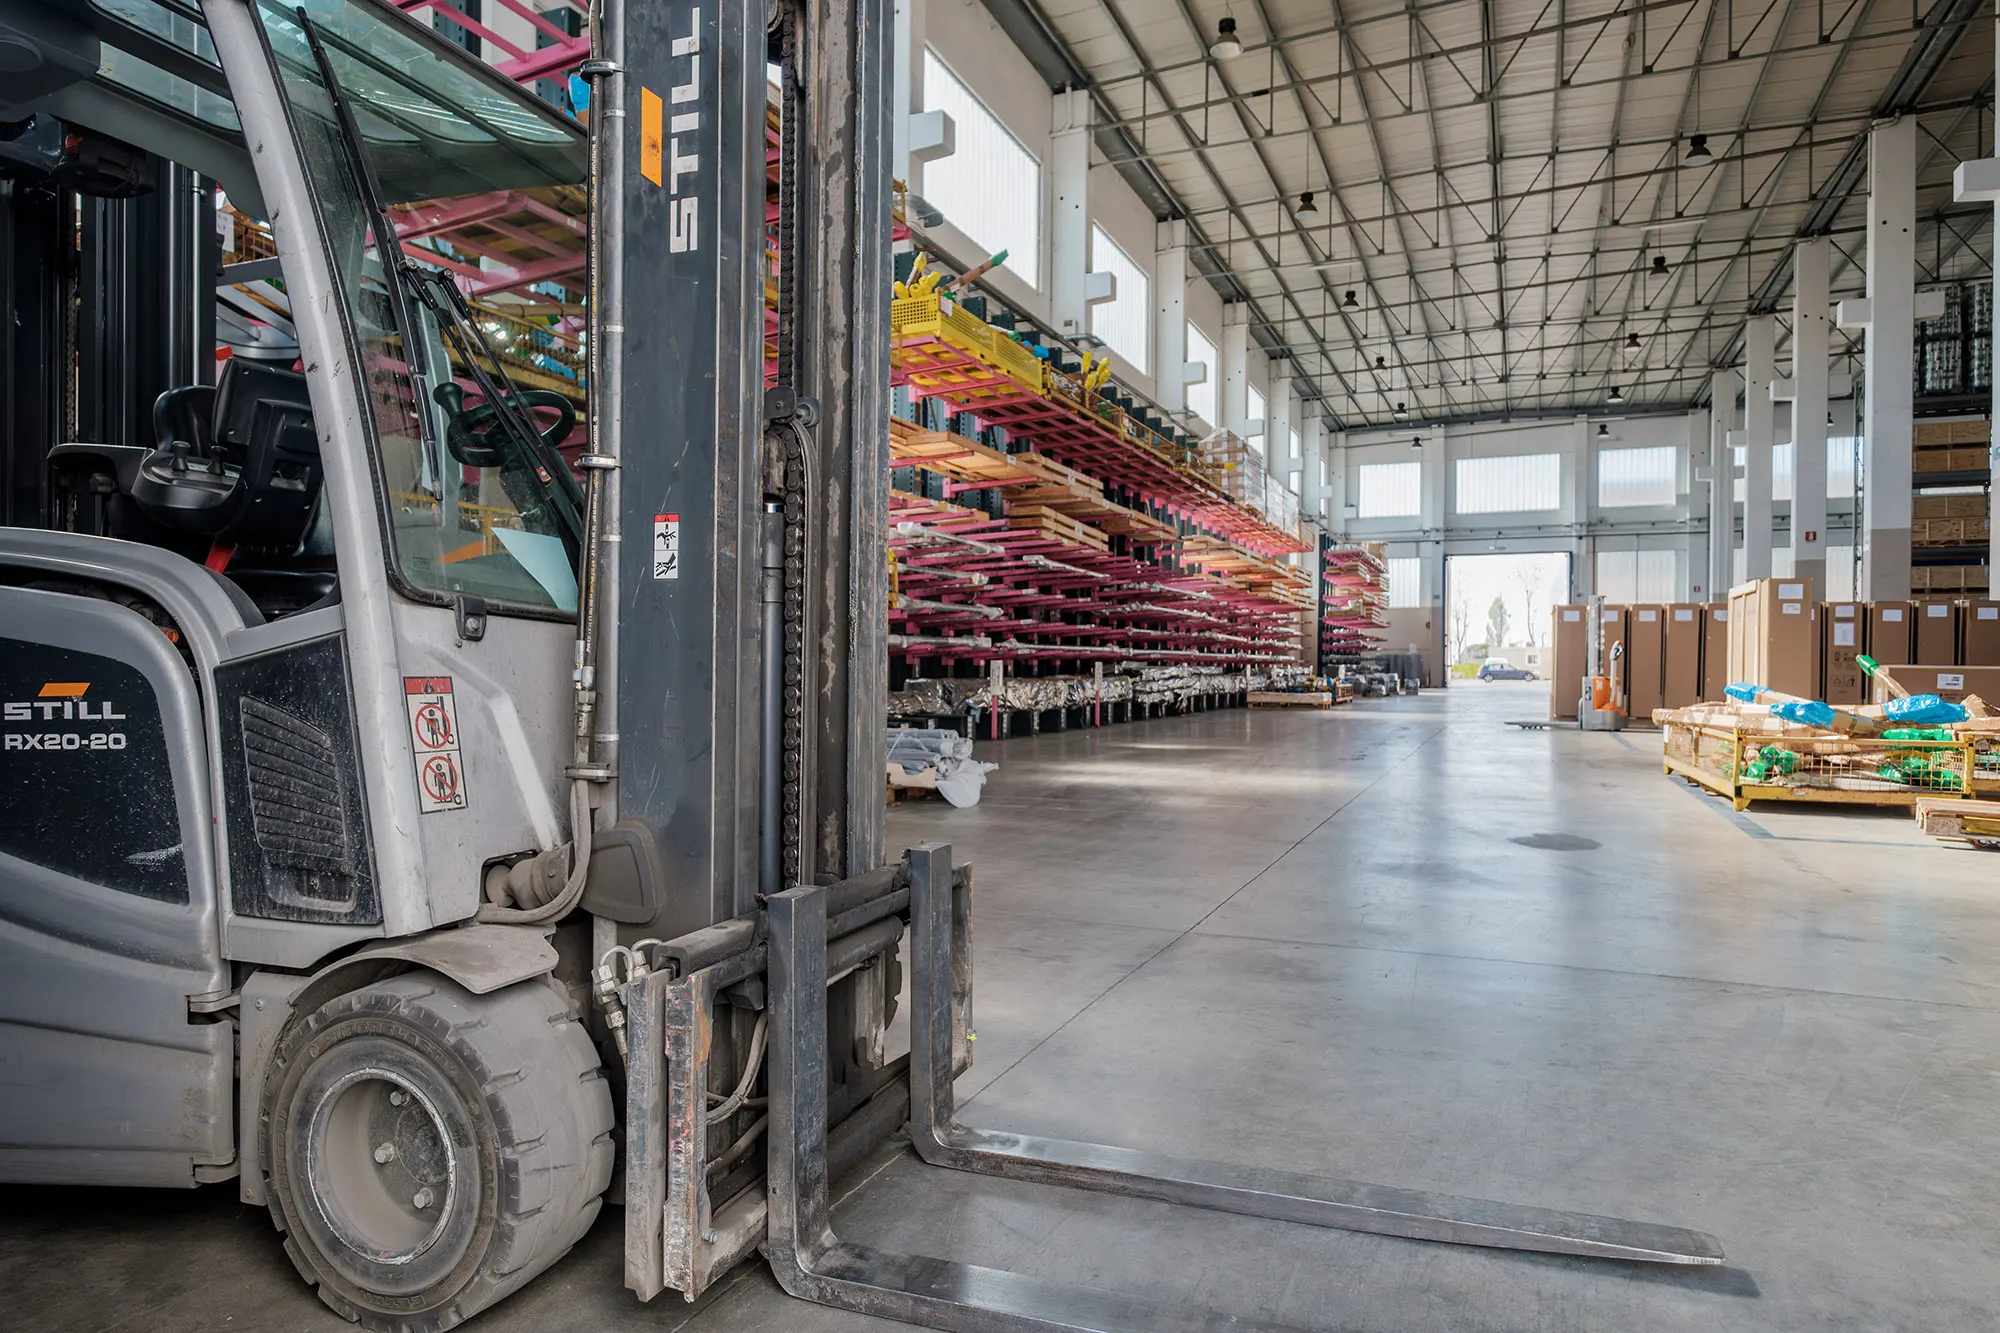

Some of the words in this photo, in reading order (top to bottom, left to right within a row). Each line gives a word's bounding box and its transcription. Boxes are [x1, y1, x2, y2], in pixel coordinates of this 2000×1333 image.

[669, 6, 701, 254] STILL
[4, 701, 127, 721] STILL
[4, 733, 127, 751] RX20-20
